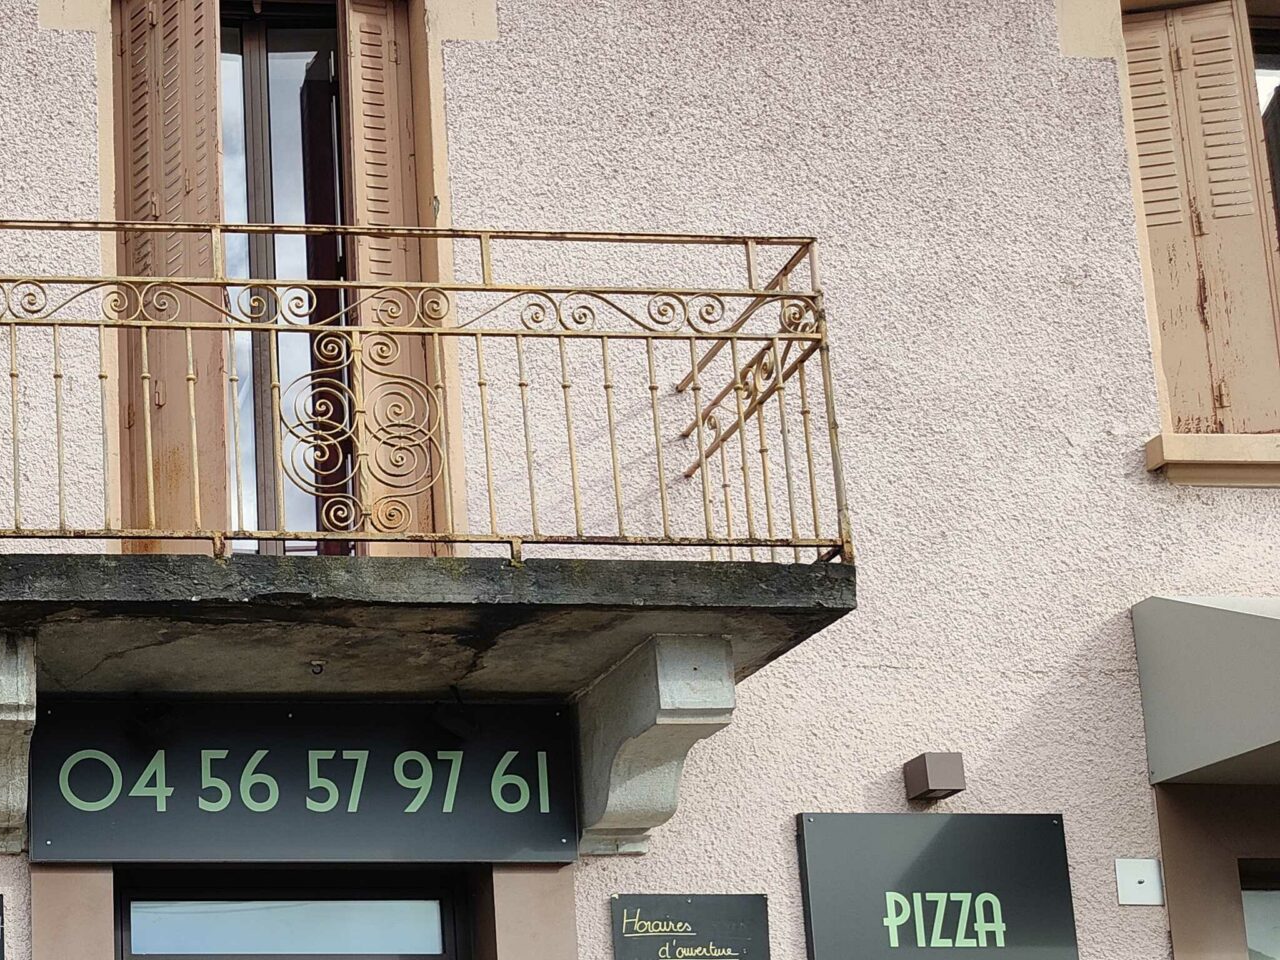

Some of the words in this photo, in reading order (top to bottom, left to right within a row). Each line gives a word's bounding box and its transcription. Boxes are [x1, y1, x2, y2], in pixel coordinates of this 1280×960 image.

[59, 748, 174, 812] 04
[198, 749, 280, 812] 56
[305, 750, 369, 813] 57
[393, 751, 464, 813] 97
[490, 751, 550, 813] 61
[623, 908, 692, 933] Horaires
[883, 891, 1006, 948] PIZZA
